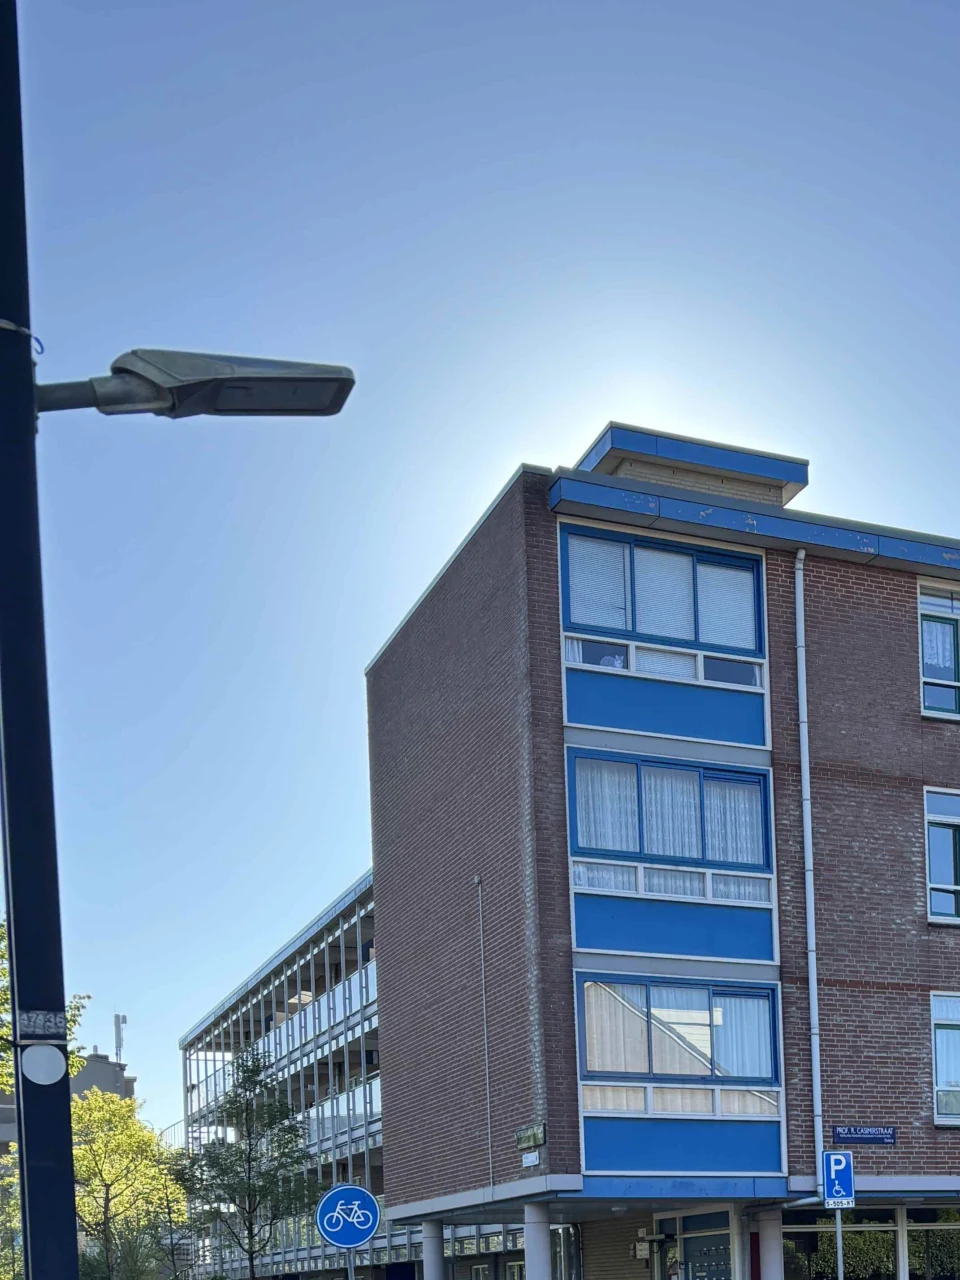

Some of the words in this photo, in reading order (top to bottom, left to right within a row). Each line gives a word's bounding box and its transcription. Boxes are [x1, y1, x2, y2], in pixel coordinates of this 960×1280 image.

[836, 1126, 850, 1134] PROF.
[857, 1127, 894, 1135] CASIMIRSTRAAT
[830, 1155, 846, 1179] P
